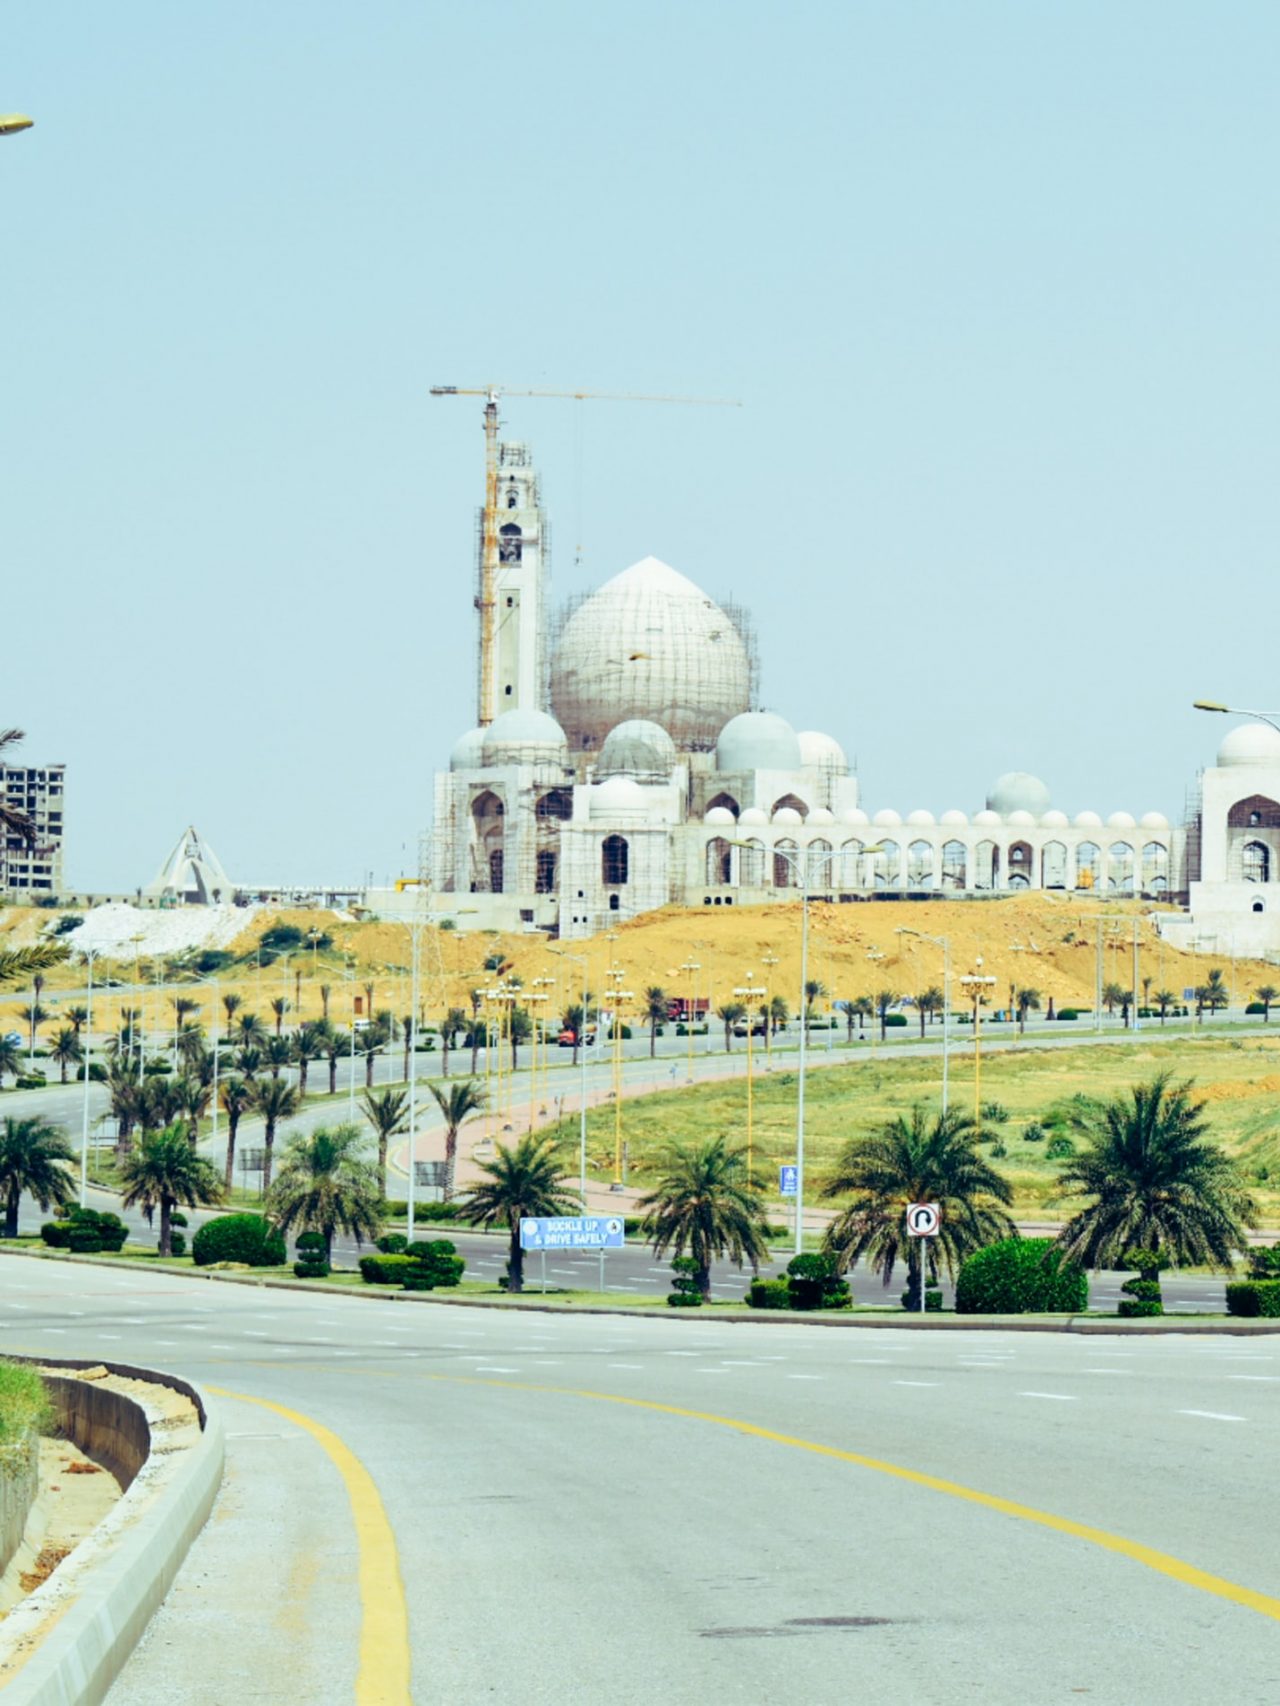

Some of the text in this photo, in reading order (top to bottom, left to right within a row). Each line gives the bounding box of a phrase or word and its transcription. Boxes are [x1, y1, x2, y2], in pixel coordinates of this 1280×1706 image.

[547, 1220, 598, 1232] BUCKLE UP
[545, 1233, 571, 1245] DRIVE
[574, 1233, 608, 1244] SAFELY
